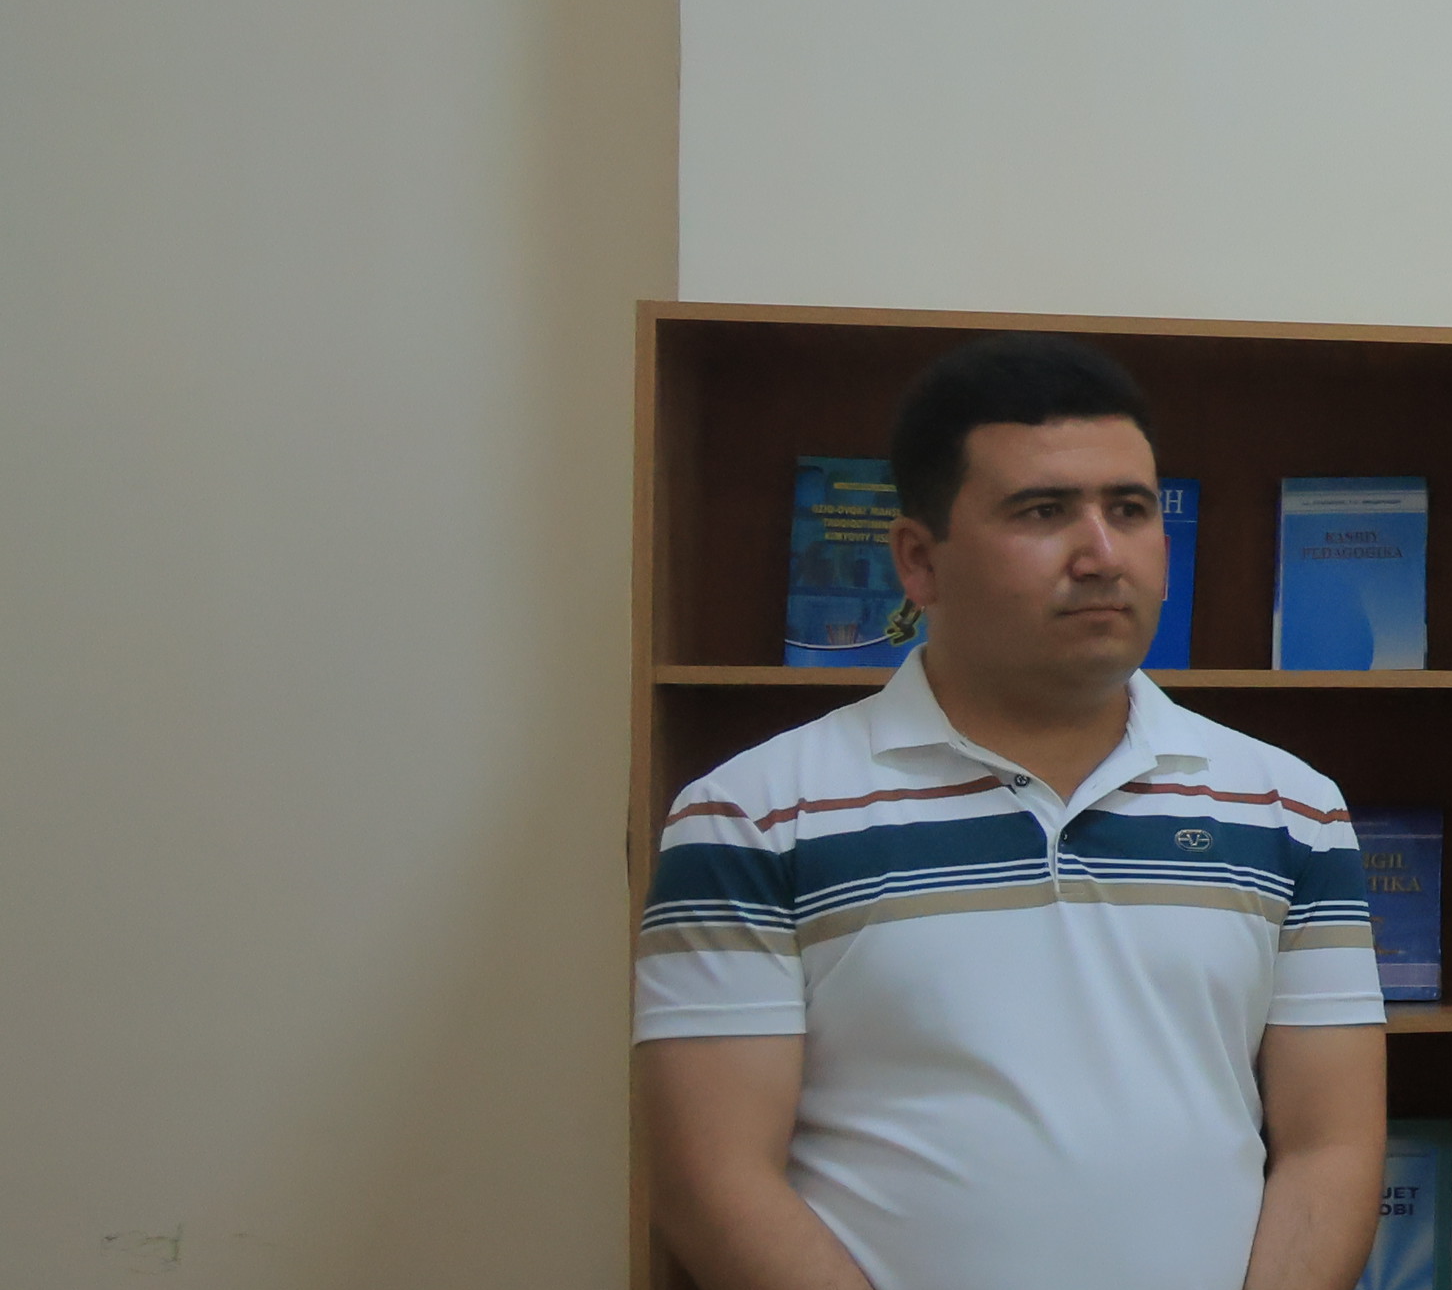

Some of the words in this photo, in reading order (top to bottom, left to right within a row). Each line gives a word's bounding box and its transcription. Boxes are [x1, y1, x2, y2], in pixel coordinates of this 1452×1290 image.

[1303, 546, 1403, 558] PEDAGOGIKA
[1368, 876, 1422, 893] TIKA
[1382, 1187, 1419, 1199] JET
[1379, 1203, 1414, 1216] OBI
